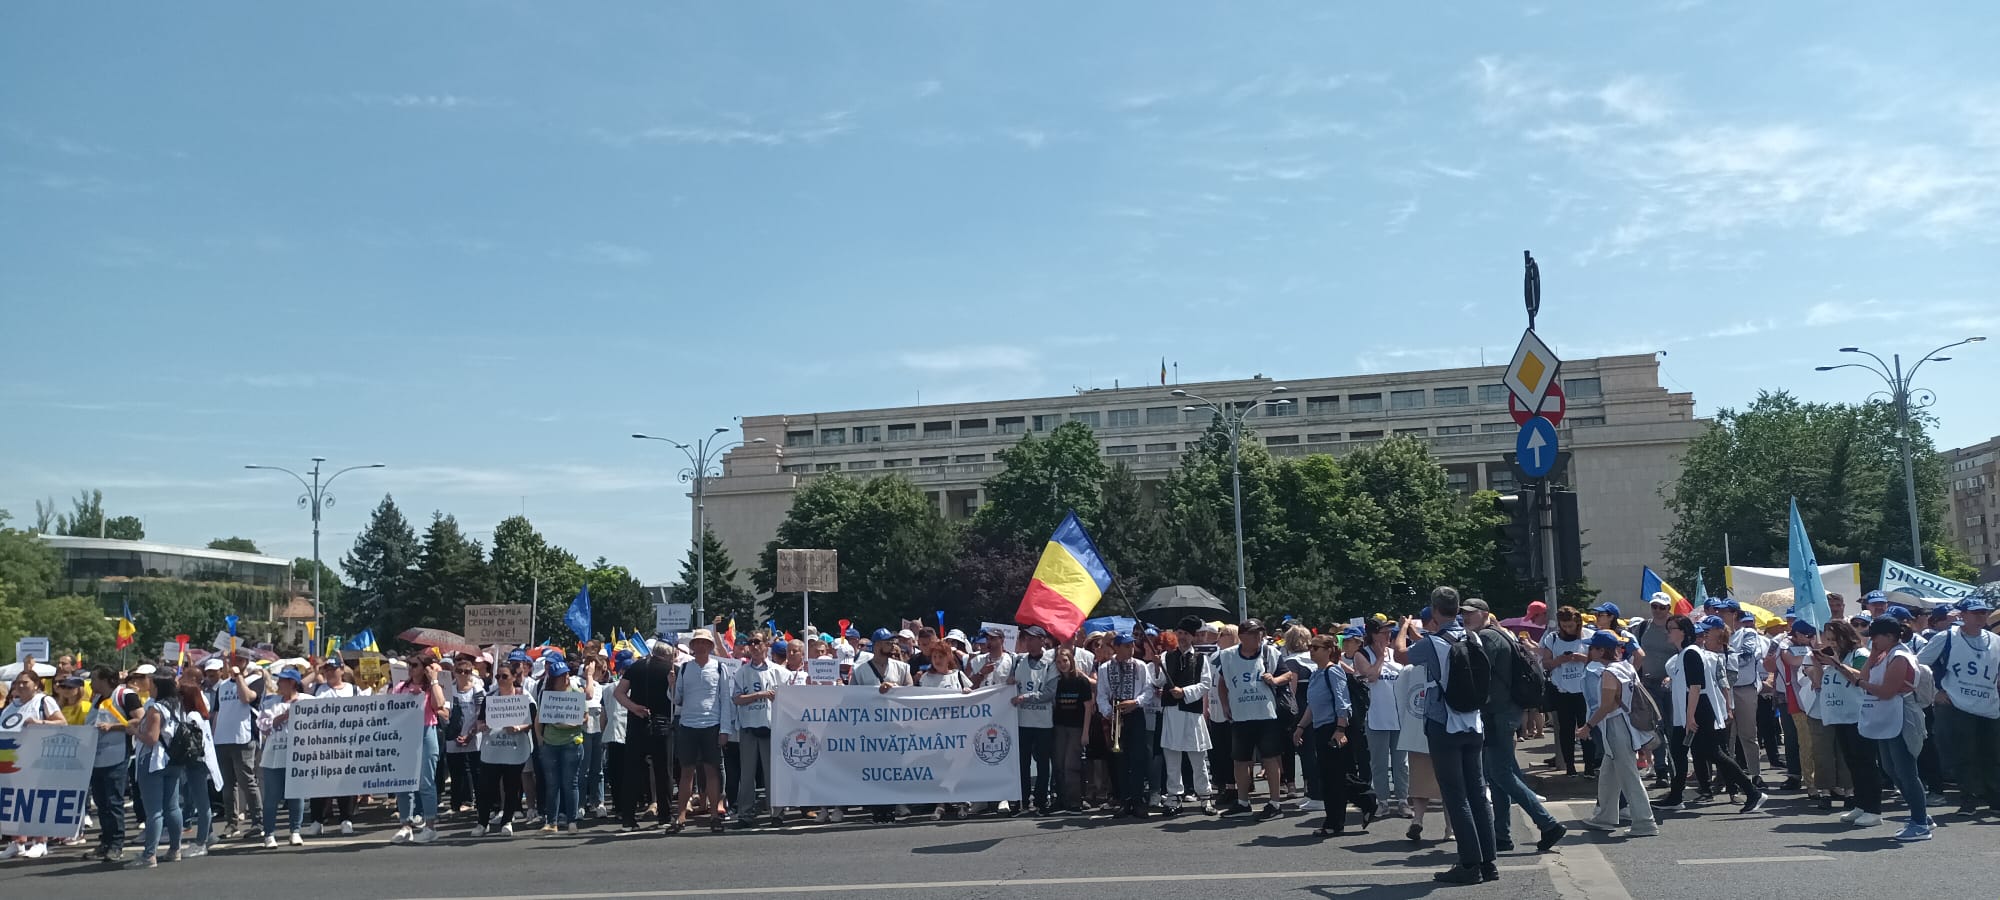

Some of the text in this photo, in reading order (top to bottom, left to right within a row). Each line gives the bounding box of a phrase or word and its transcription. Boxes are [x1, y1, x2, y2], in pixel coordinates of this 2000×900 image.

[1960, 687, 1990, 699] TECUCI
[295, 700, 419, 717] După chip cunoști o floare,
[800, 703, 993, 726] ALIANȚA SINDICATELOR
[294, 717, 390, 731] Ciocârlia, după cânt.
[293, 736, 305, 746] Pe
[307, 734, 347, 745] Iohannis
[348, 733, 357, 746] și
[358, 735, 371, 745] pe
[372, 730, 402, 742] Ciucă,
[827, 733, 967, 755] DIN ÎNVĂȚĂMÂNT
[292, 747, 400, 763] După bâlbâit mai tare,
[291, 762, 396, 779] Dar și lipsa de cuvânt.
[862, 766, 934, 781] SUCEAVA
[0, 787, 86, 825] ENTE!
